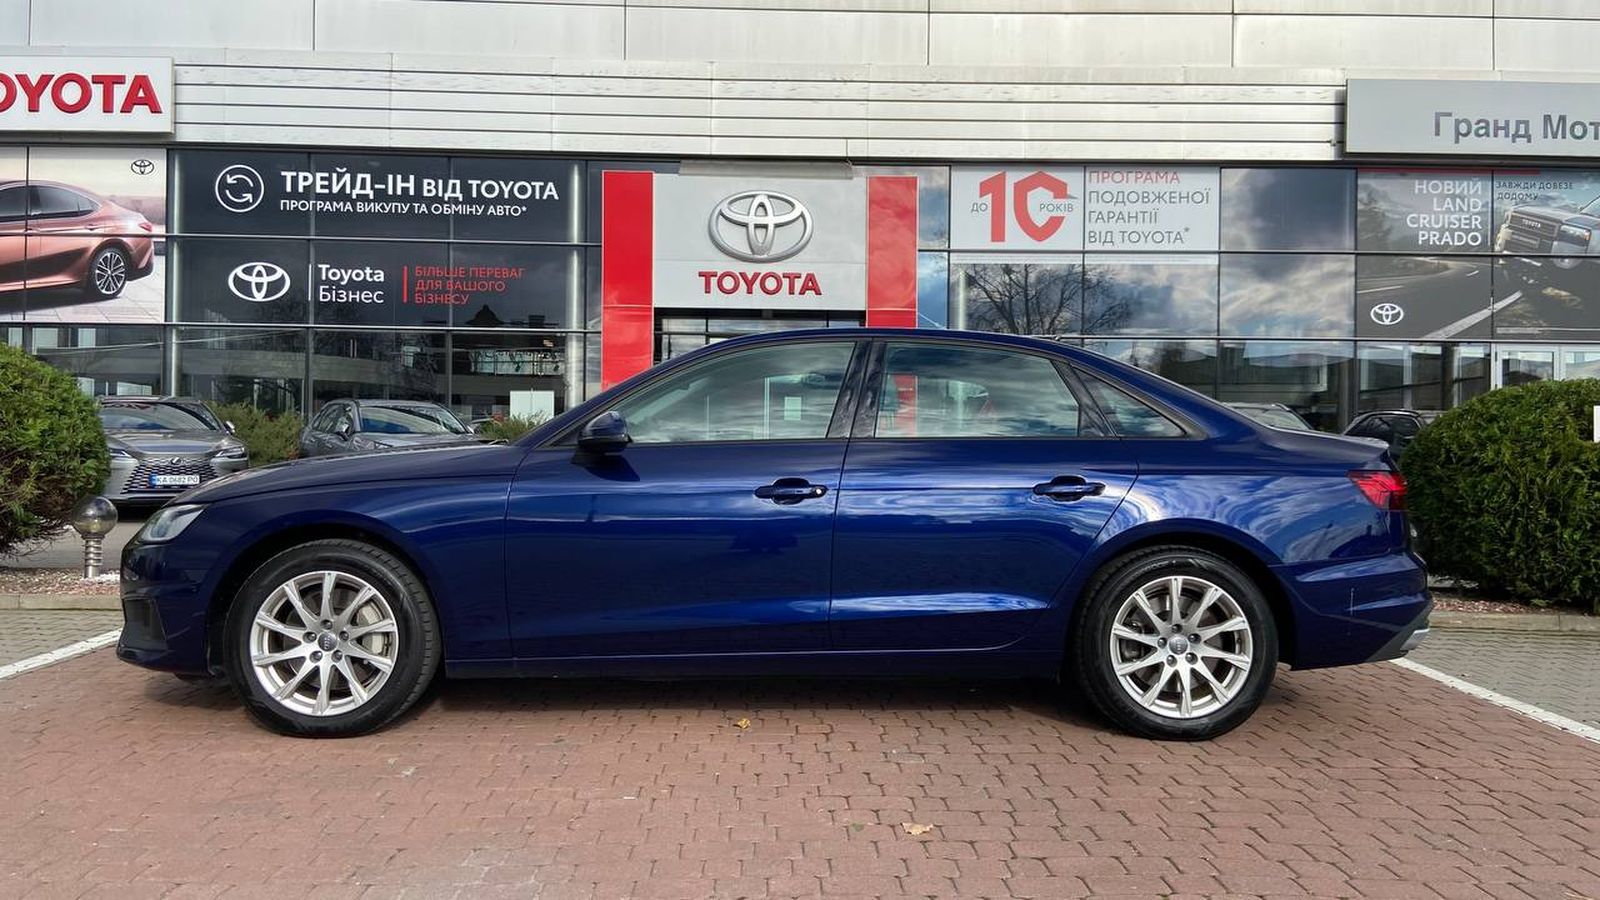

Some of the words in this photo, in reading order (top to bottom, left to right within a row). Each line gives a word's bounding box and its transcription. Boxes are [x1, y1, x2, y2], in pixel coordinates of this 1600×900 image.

[1434, 112, 1532, 144] Гранд
[280, 167, 415, 199] ТРЕЙД-ІН
[422, 178, 463, 201] ВІД
[467, 179, 559, 200] TOYOTA
[1088, 171, 1181, 184] ПРОГРАМА
[1414, 177, 1482, 195] НОВИЙ
[1496, 181, 1537, 191] ЗАВЖДИ
[1539, 182, 1574, 191] ДОВЕЗЕ
[1088, 188, 1211, 206] ПОДОВЖЕНОЇ
[1433, 198, 1482, 212] LAND
[280, 199, 354, 212] ПРОГРАМА
[356, 201, 410, 214] ВИКУПУ
[412, 203, 429, 214] ТА
[431, 203, 485, 216] ОБМІНУ
[970, 202, 989, 213] ДО
[1039, 203, 1074, 213] РОКІВ
[1088, 208, 1159, 225] ГАРАНТІЇ
[1406, 213, 1482, 229] CRUISER
[1088, 230, 1114, 246] ВІД
[1418, 230, 1482, 246] PRADO
[317, 264, 385, 285] Toyota
[414, 266, 466, 277] БІЛЬШЕ
[469, 267, 526, 278] ПЕРЕВАГ
[415, 280, 442, 291] ДЛЯ
[446, 281, 506, 292] ВАШОГО
[698, 271, 822, 295] TOYOTA
[318, 286, 385, 303] Бізнес
[414, 293, 470, 305] БІЗНЕСУ
